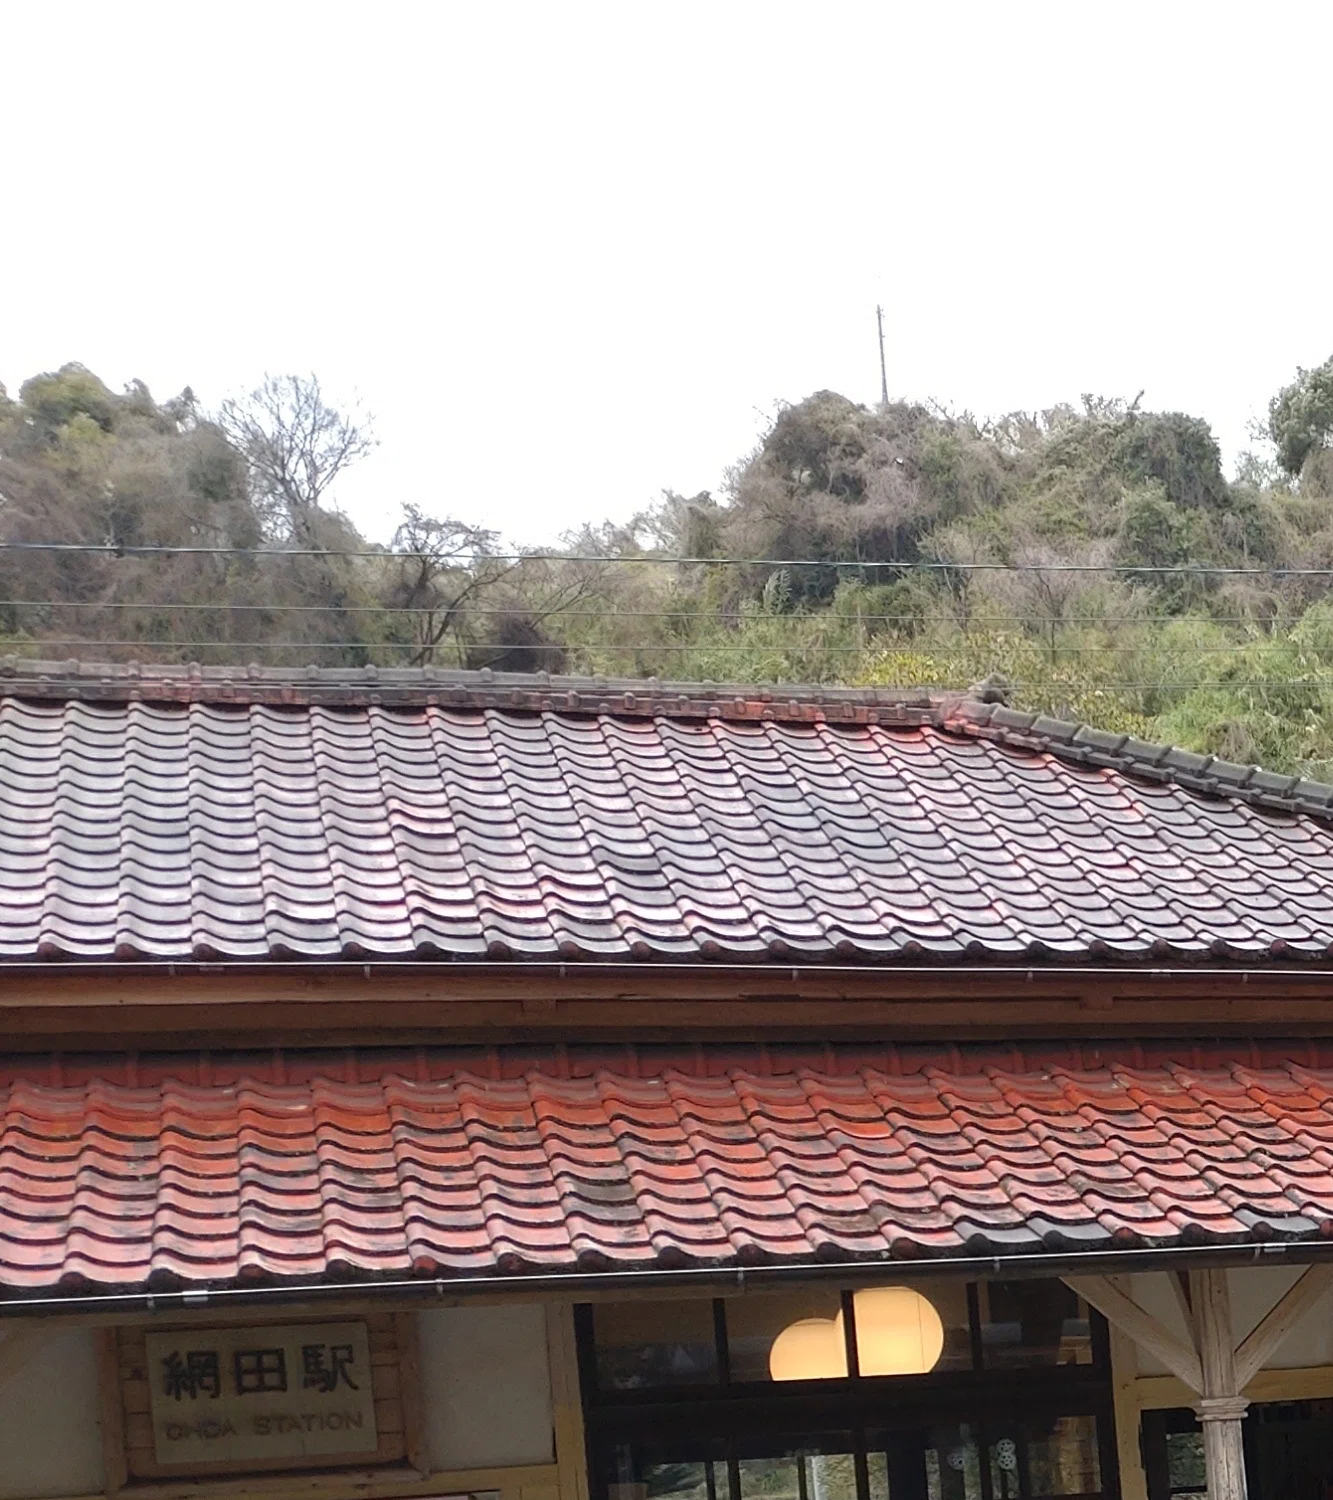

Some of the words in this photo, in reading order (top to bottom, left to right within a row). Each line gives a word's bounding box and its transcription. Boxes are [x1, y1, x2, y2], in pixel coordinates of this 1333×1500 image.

[162, 1343, 359, 1401] 網田駅
[253, 1410, 364, 1436] STATION
